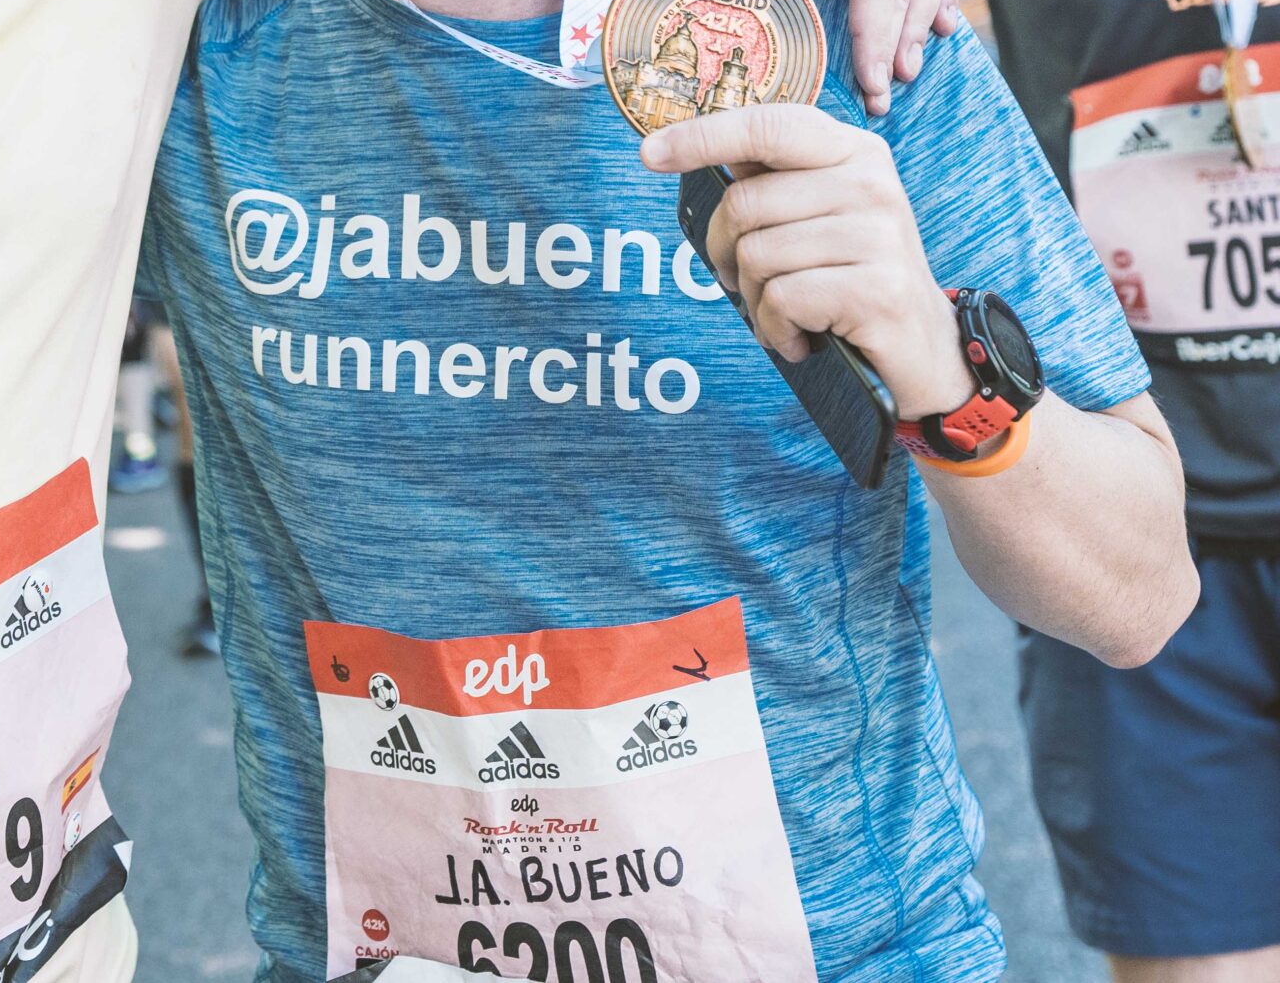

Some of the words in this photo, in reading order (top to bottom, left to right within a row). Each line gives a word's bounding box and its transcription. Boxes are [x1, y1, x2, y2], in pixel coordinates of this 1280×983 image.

[699, 11, 746, 37] 42K
[225, 188, 728, 302] @jabueno
[252, 325, 701, 414] runnercito
[1, 601, 62, 649] adidas
[463, 643, 550, 705] edp
[370, 747, 437, 775] adidas
[478, 758, 560, 784] adidas
[616, 739, 698, 773] adidas
[511, 794, 540, 817] edp
[482, 837, 543, 845] MARATHON
[482, 844, 582, 855] MADRID
[521, 846, 684, 905] BUENO
[363, 919, 387, 931] 42K
[458, 917, 658, 983] 6200
